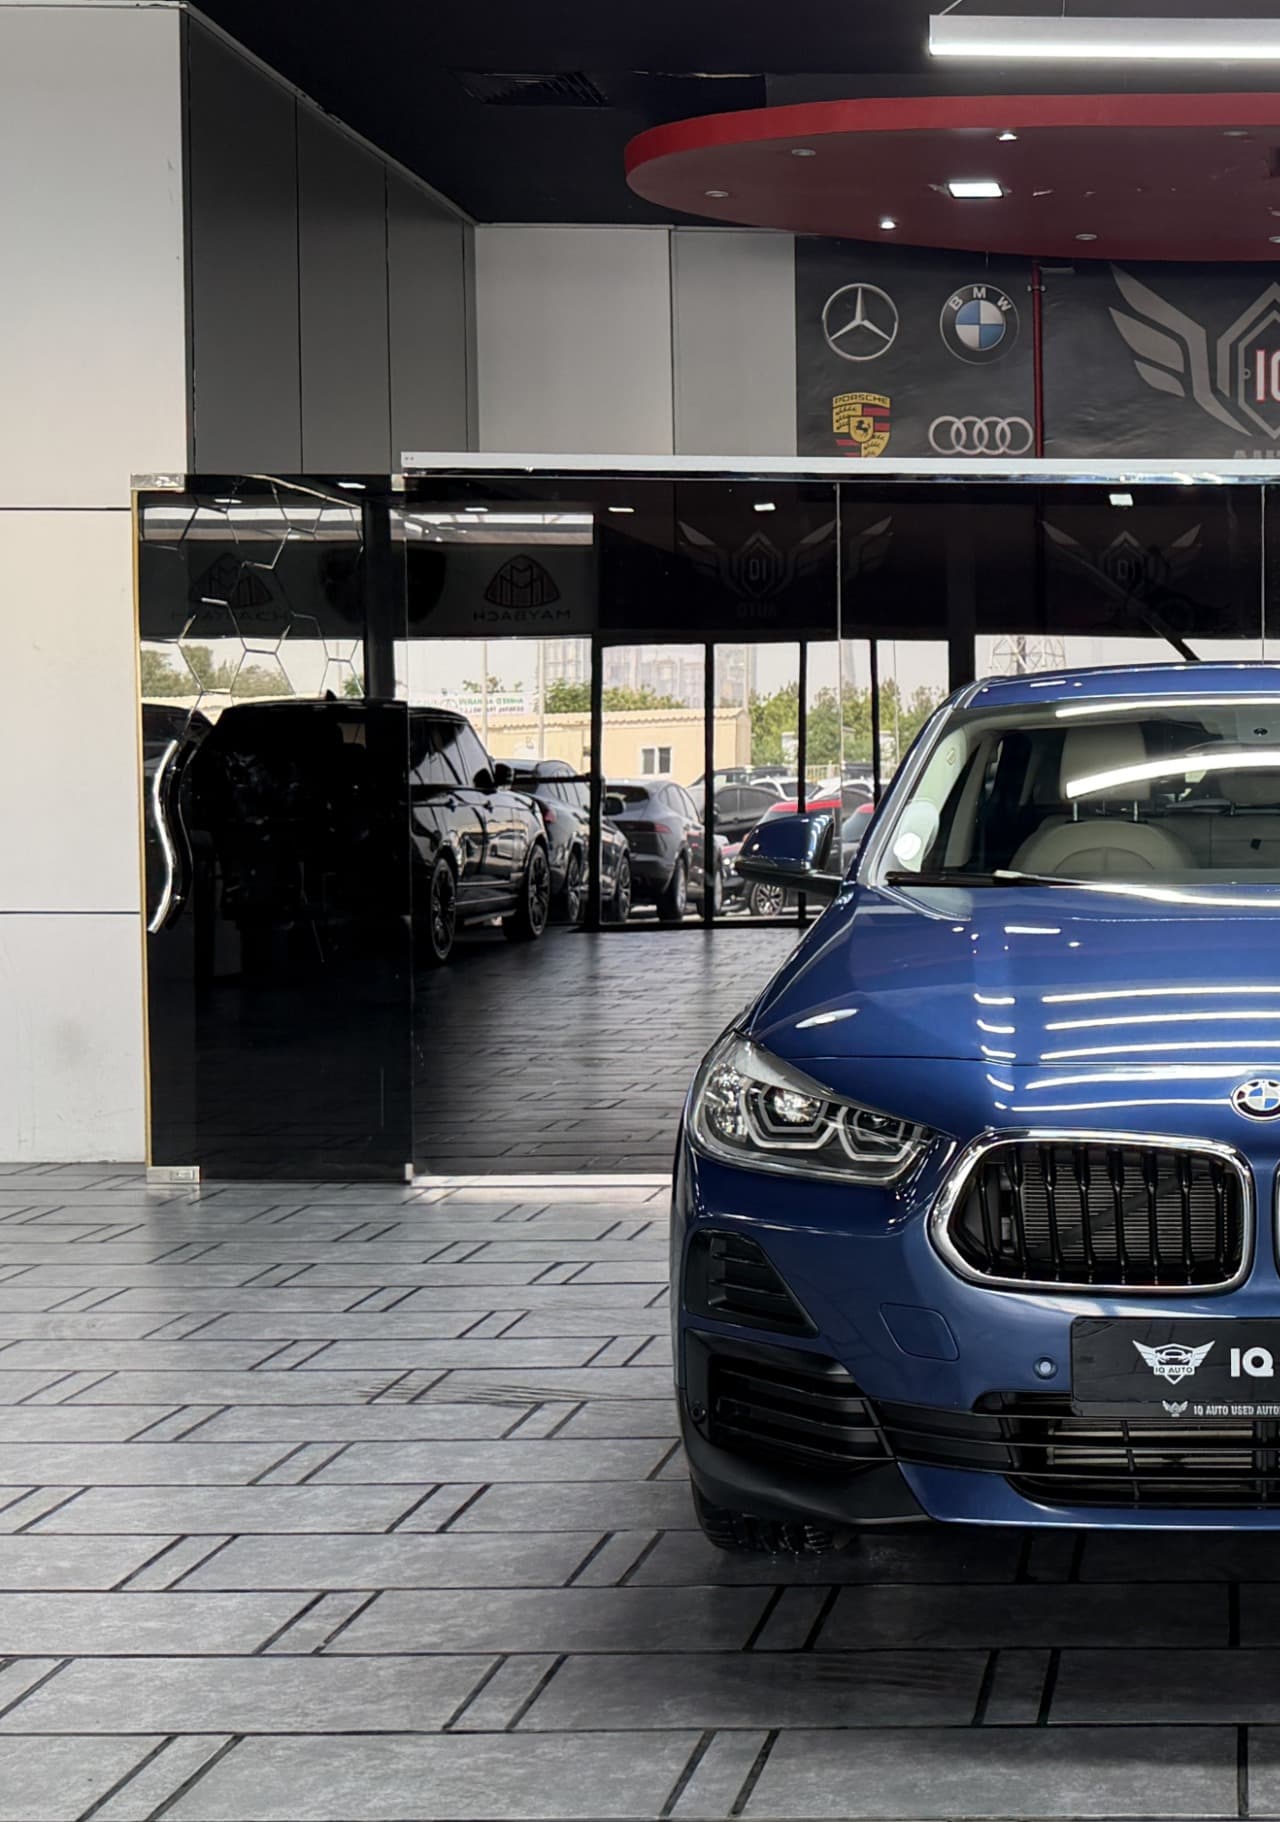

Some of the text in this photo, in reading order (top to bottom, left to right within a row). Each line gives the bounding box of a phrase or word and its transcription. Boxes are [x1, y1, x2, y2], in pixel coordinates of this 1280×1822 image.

[948, 286, 1013, 312] BMW
[834, 393, 889, 405] PORSCHE
[1230, 1346, 1274, 1378] IQ
[1155, 1366, 1193, 1374] IQ AUTO
[1193, 1405, 1204, 1415] IQ
[1206, 1405, 1229, 1415] AUTO
[1231, 1405, 1254, 1415] USED
